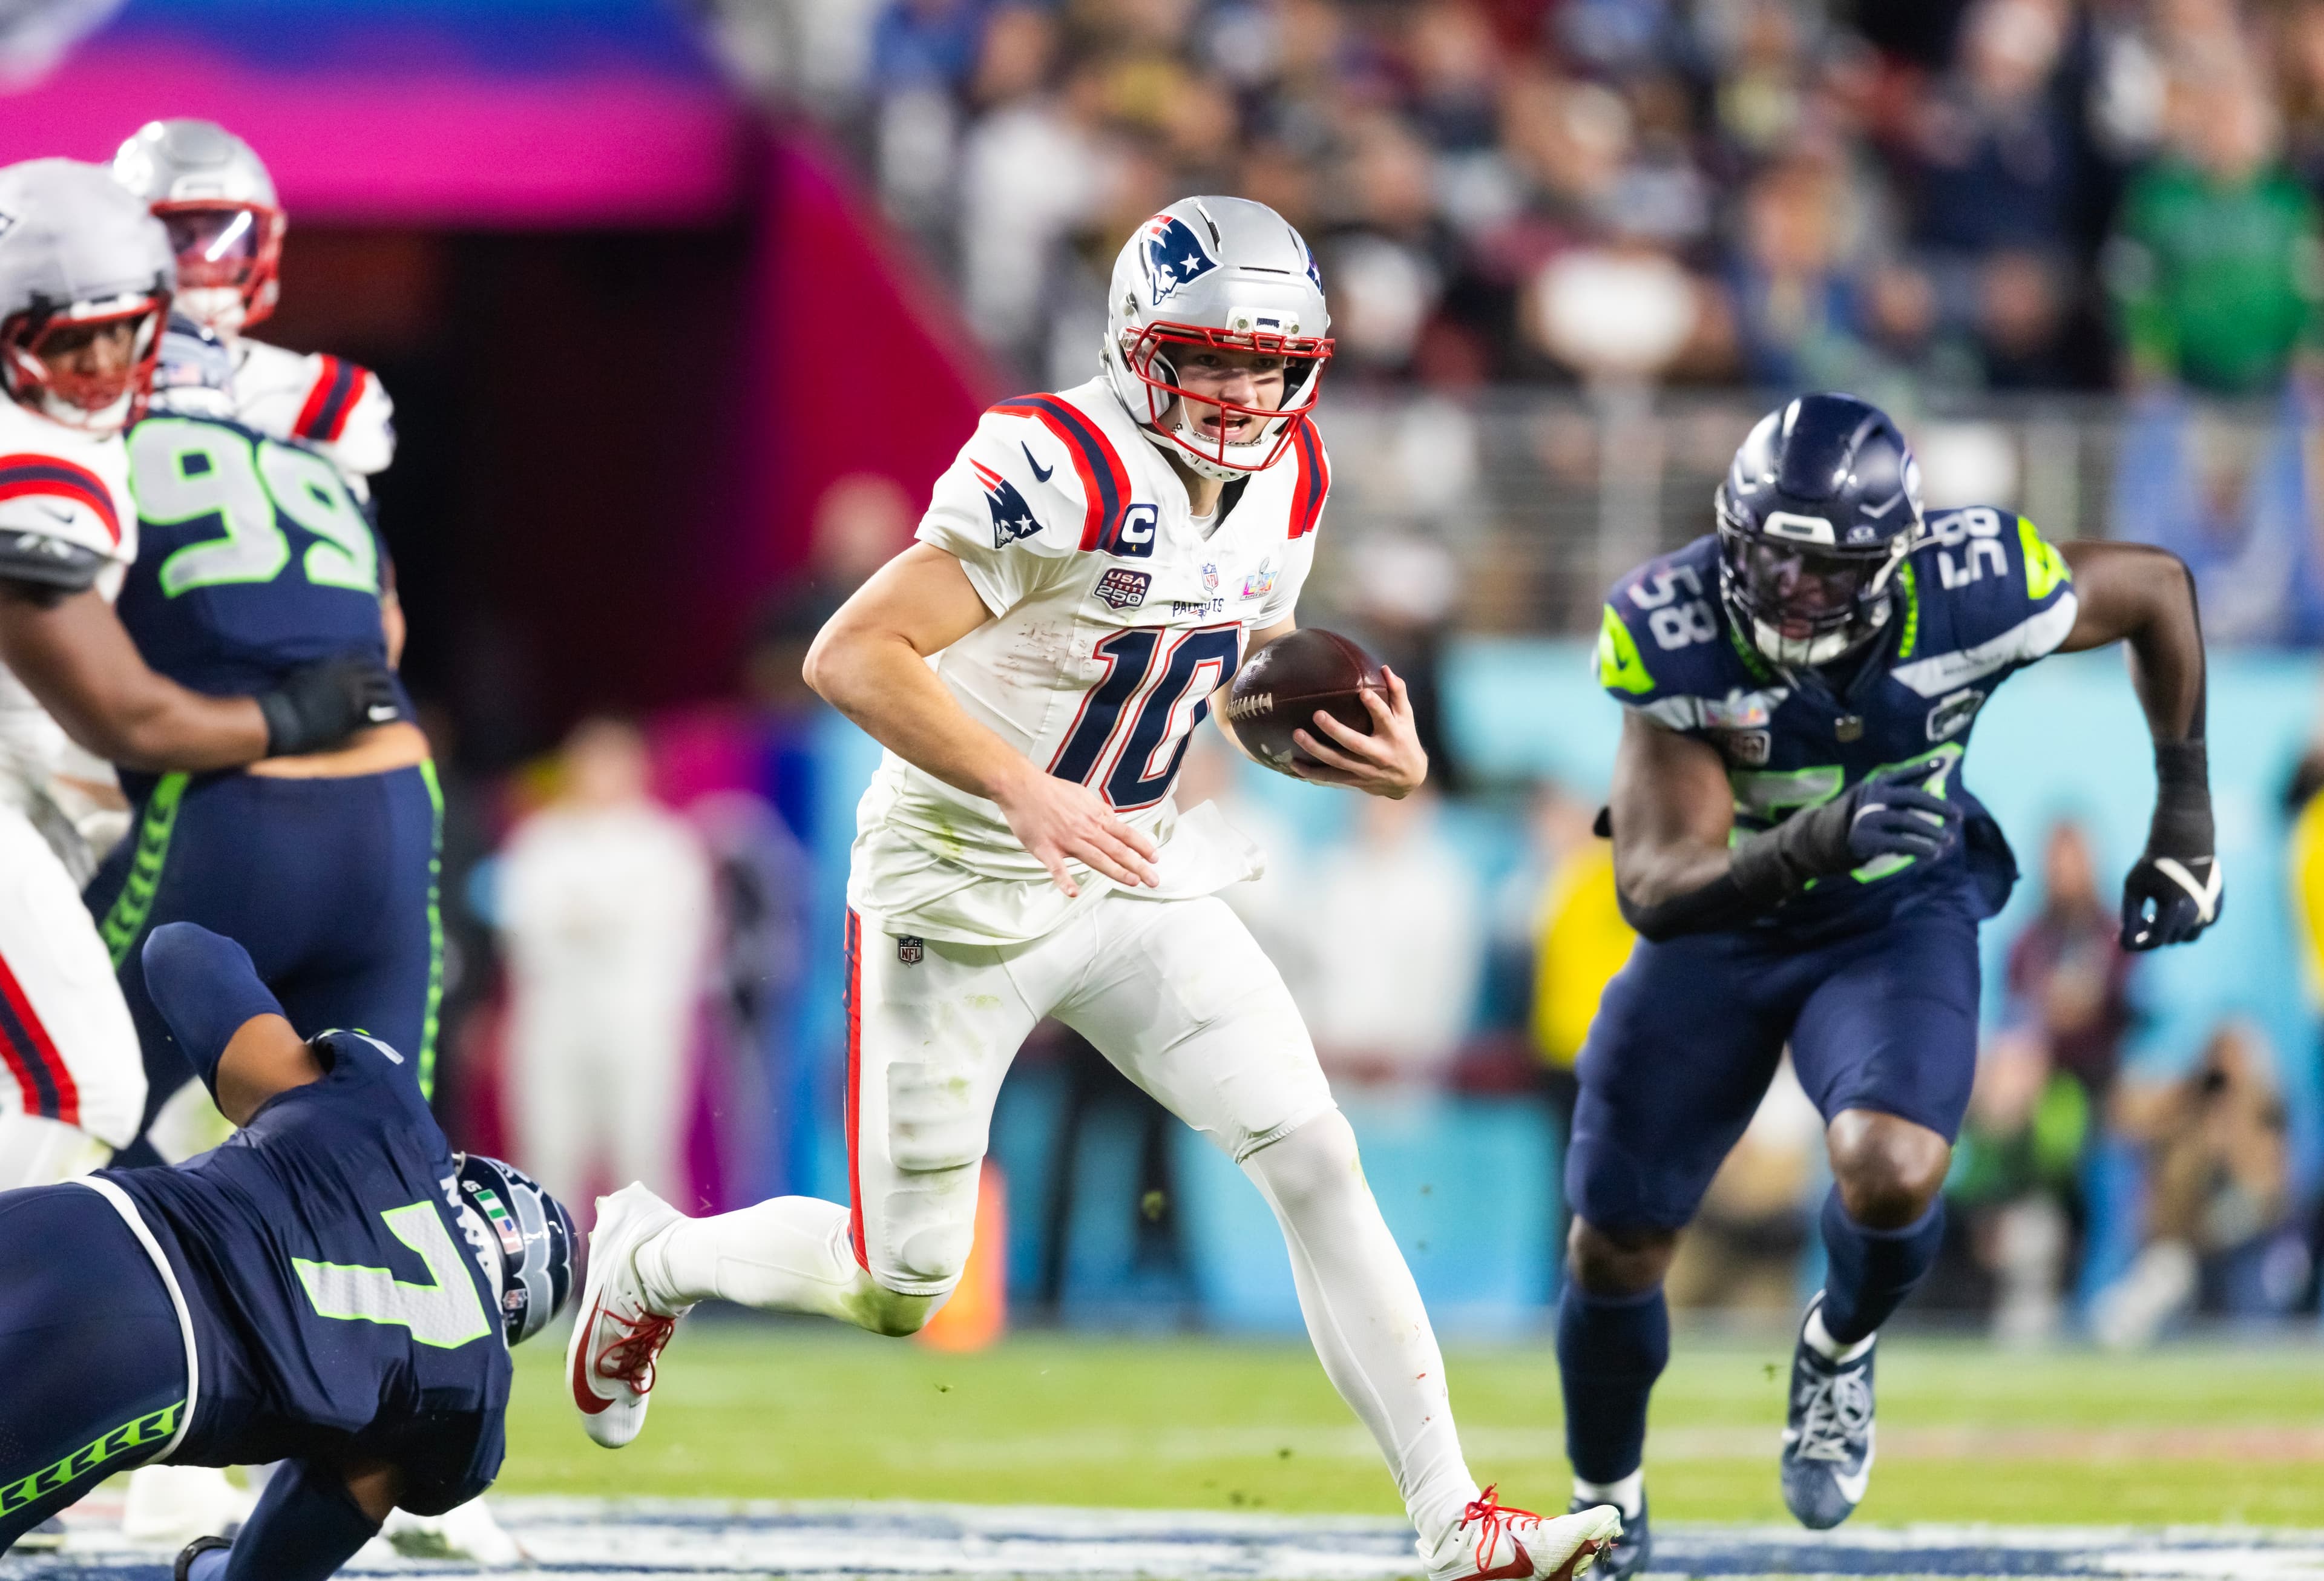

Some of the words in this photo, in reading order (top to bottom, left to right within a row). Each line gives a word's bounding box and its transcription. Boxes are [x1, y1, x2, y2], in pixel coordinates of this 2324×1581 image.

[126, 416, 378, 599] 99
[1121, 507, 1155, 544] C
[1931, 507, 2008, 590] 58
[1096, 584, 1143, 605] 250
[1107, 571, 1146, 587] USA
[1205, 574, 1219, 587] NFL
[1628, 564, 1718, 651] 58
[1045, 620, 1242, 814] 10
[901, 947, 921, 961] NFL
[291, 1200, 492, 1350] 7
